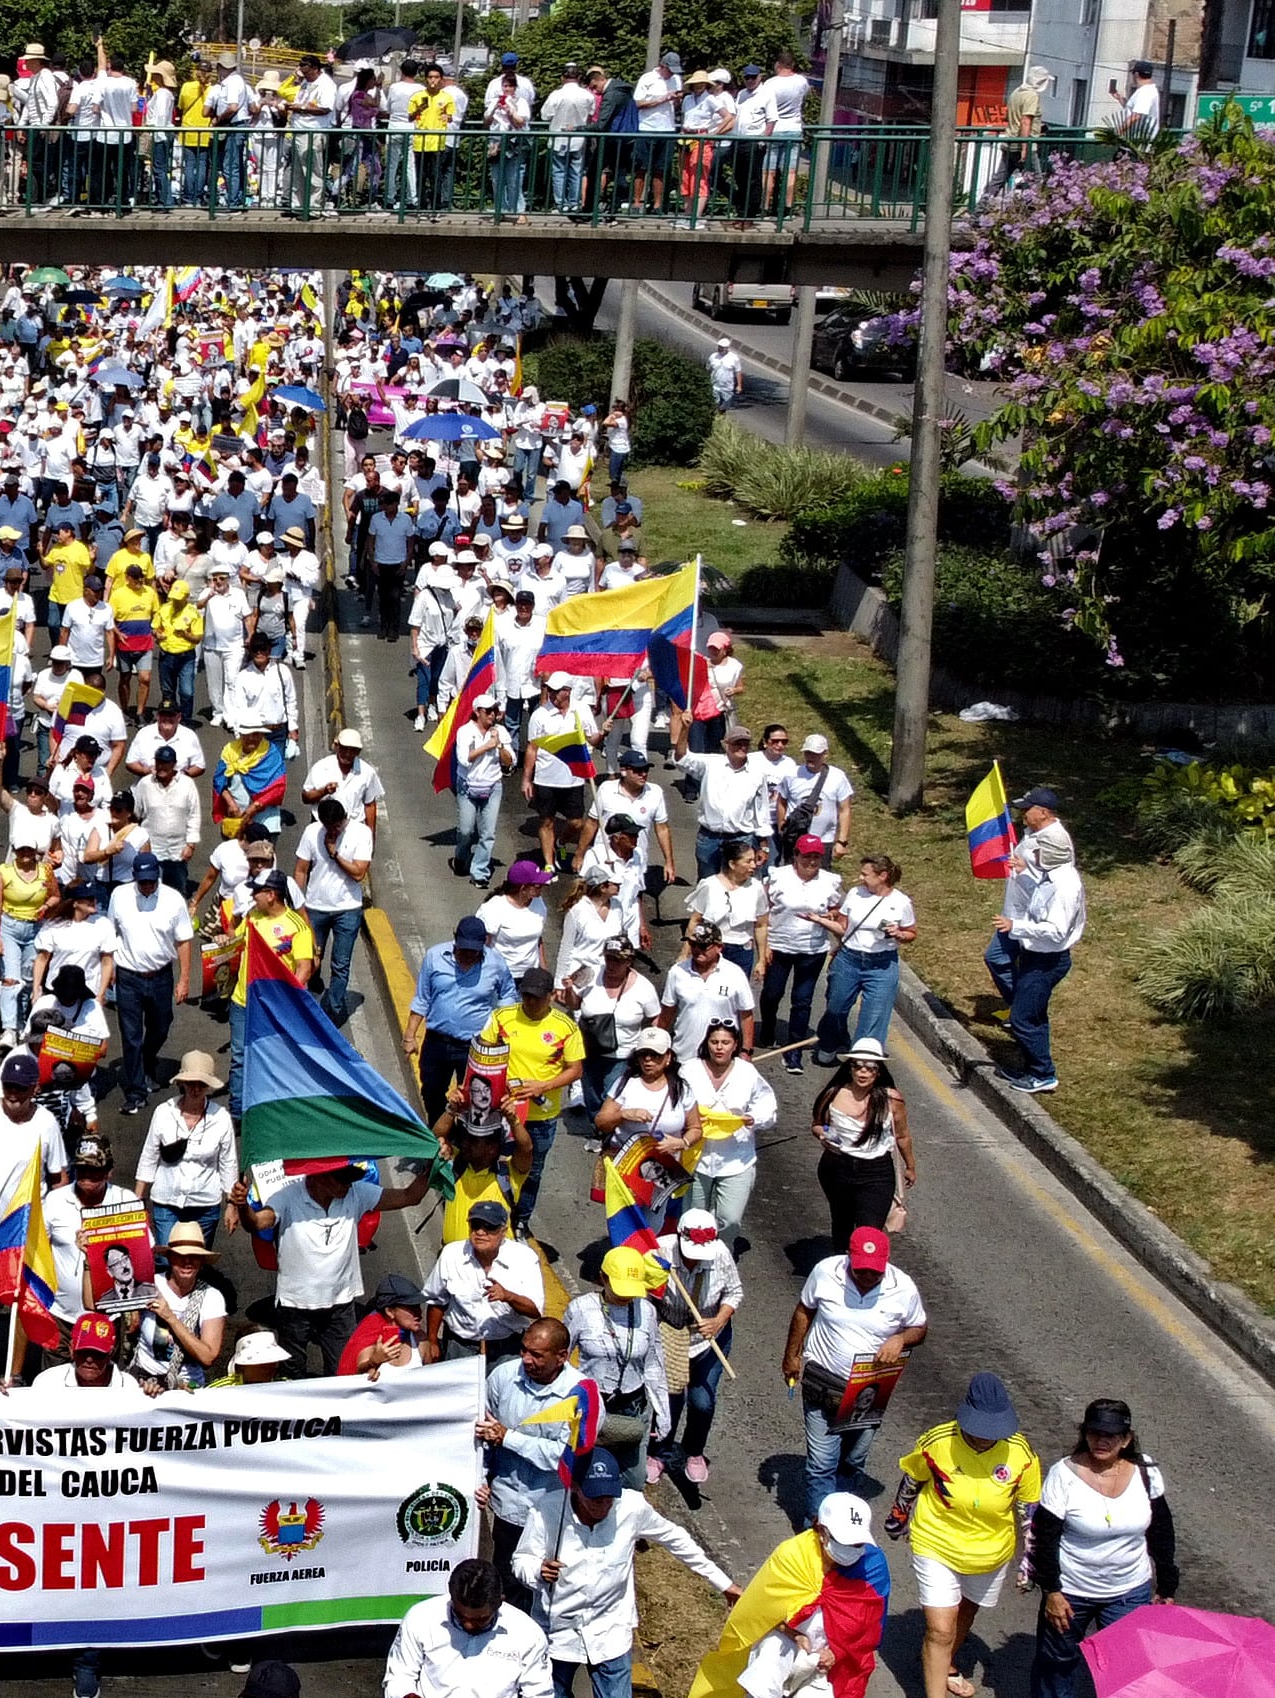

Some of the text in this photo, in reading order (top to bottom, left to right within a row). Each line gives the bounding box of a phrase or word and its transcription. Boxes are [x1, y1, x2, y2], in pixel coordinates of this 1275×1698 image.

[115, 1421, 216, 1453] FUERZA
[224, 1416, 342, 1447] PÚBLICA
[61, 1466, 158, 1498] CAUCA
[250, 1567, 326, 1585] FUERZA AEREA
[406, 1558, 450, 1572] POLICÍA
